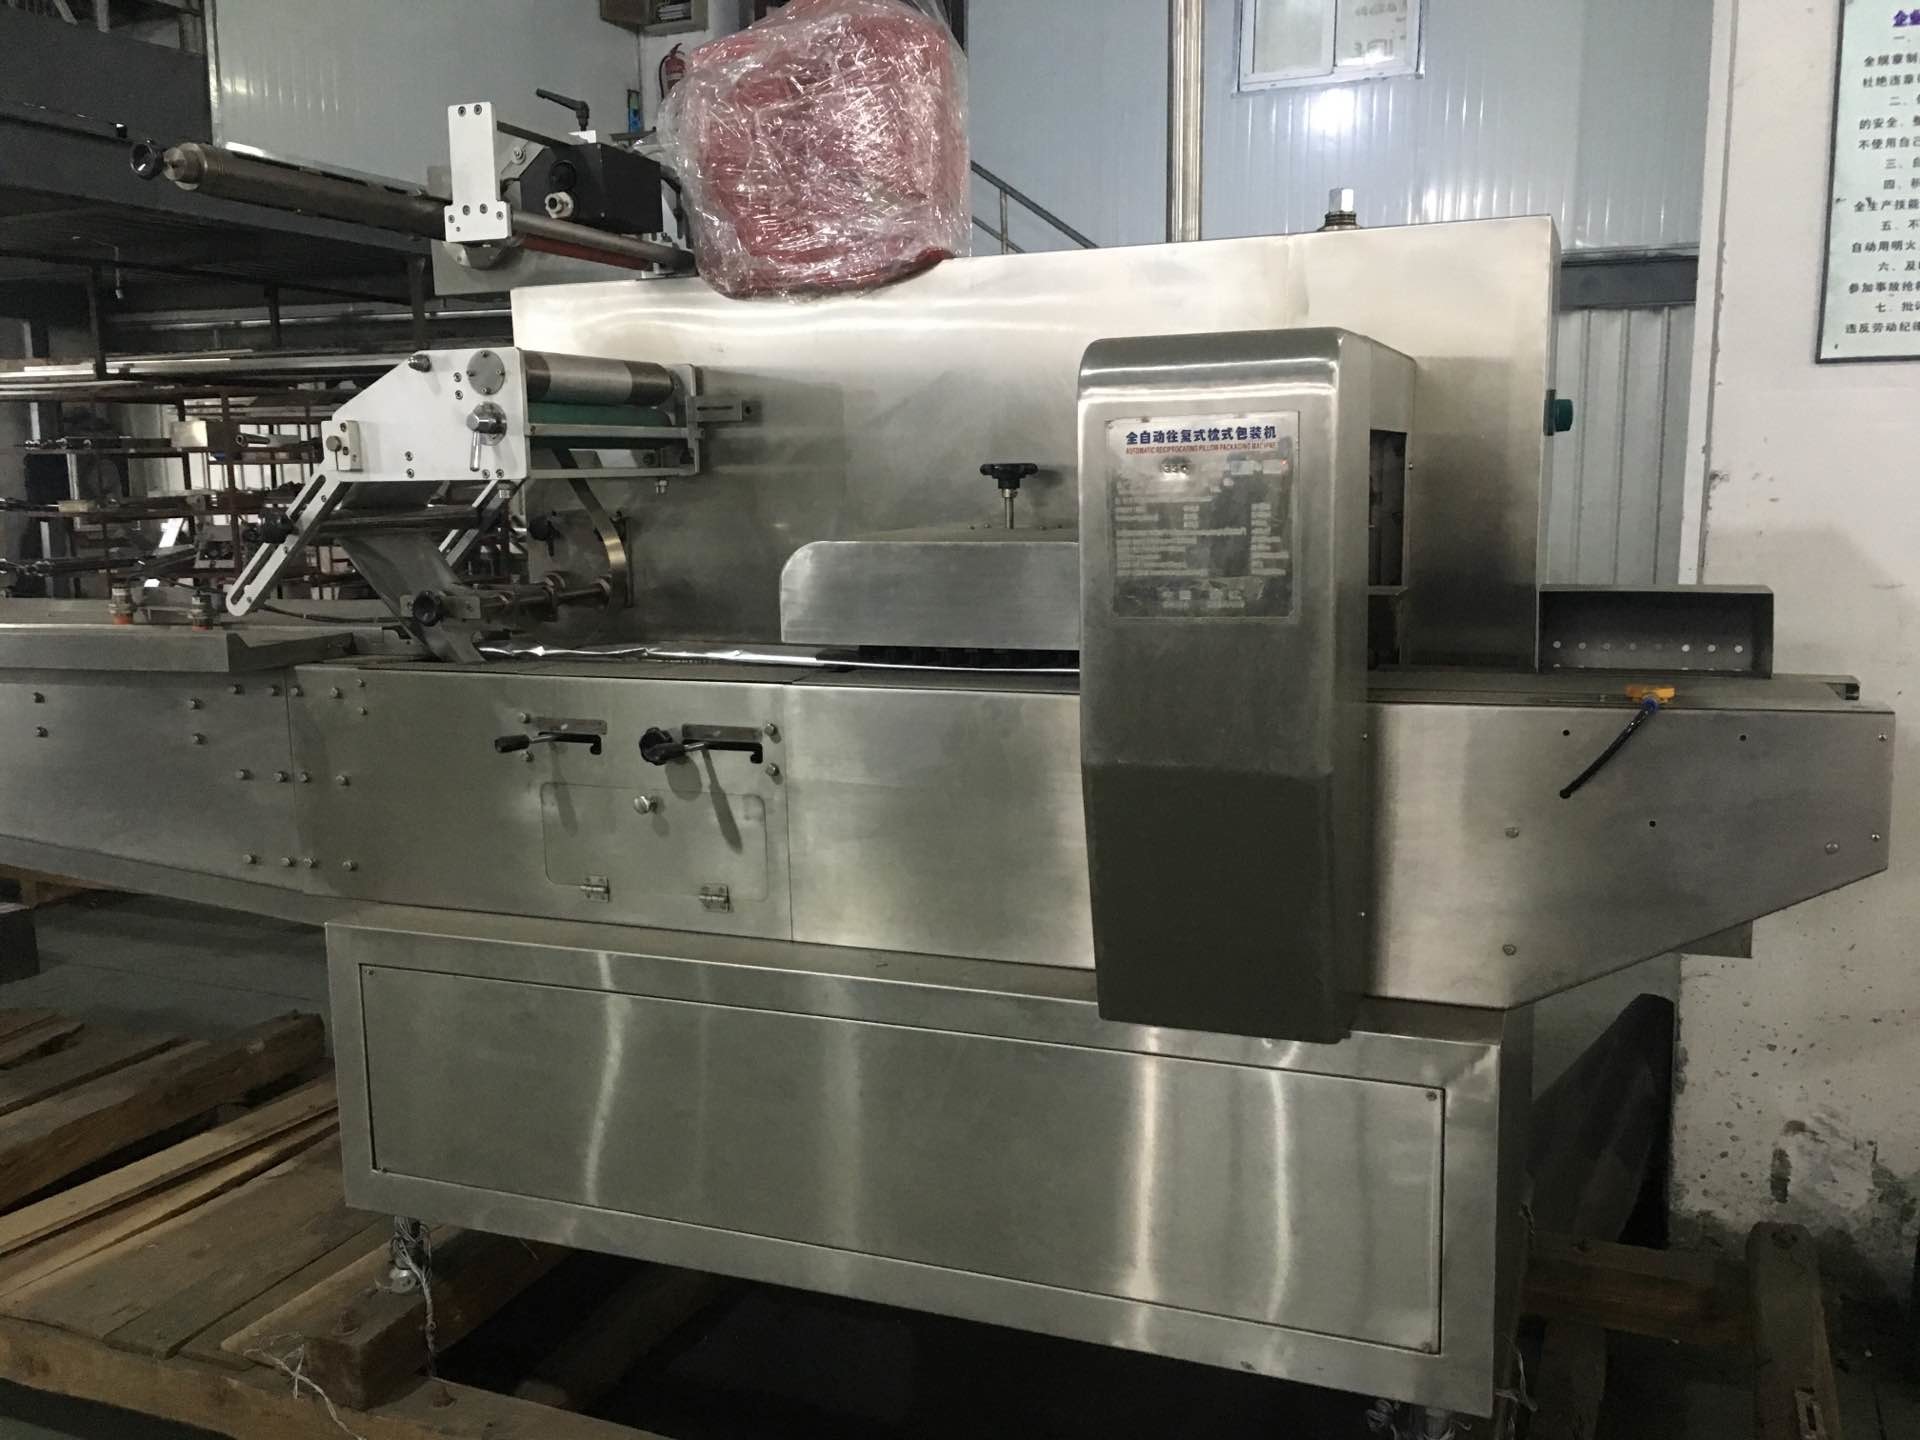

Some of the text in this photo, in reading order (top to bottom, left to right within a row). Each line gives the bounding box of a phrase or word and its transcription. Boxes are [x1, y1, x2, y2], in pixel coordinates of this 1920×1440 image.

[1863, 74, 1920, 88] 杜绝违章
[1126, 426, 1276, 445] 全自动往复式枕式包装机
